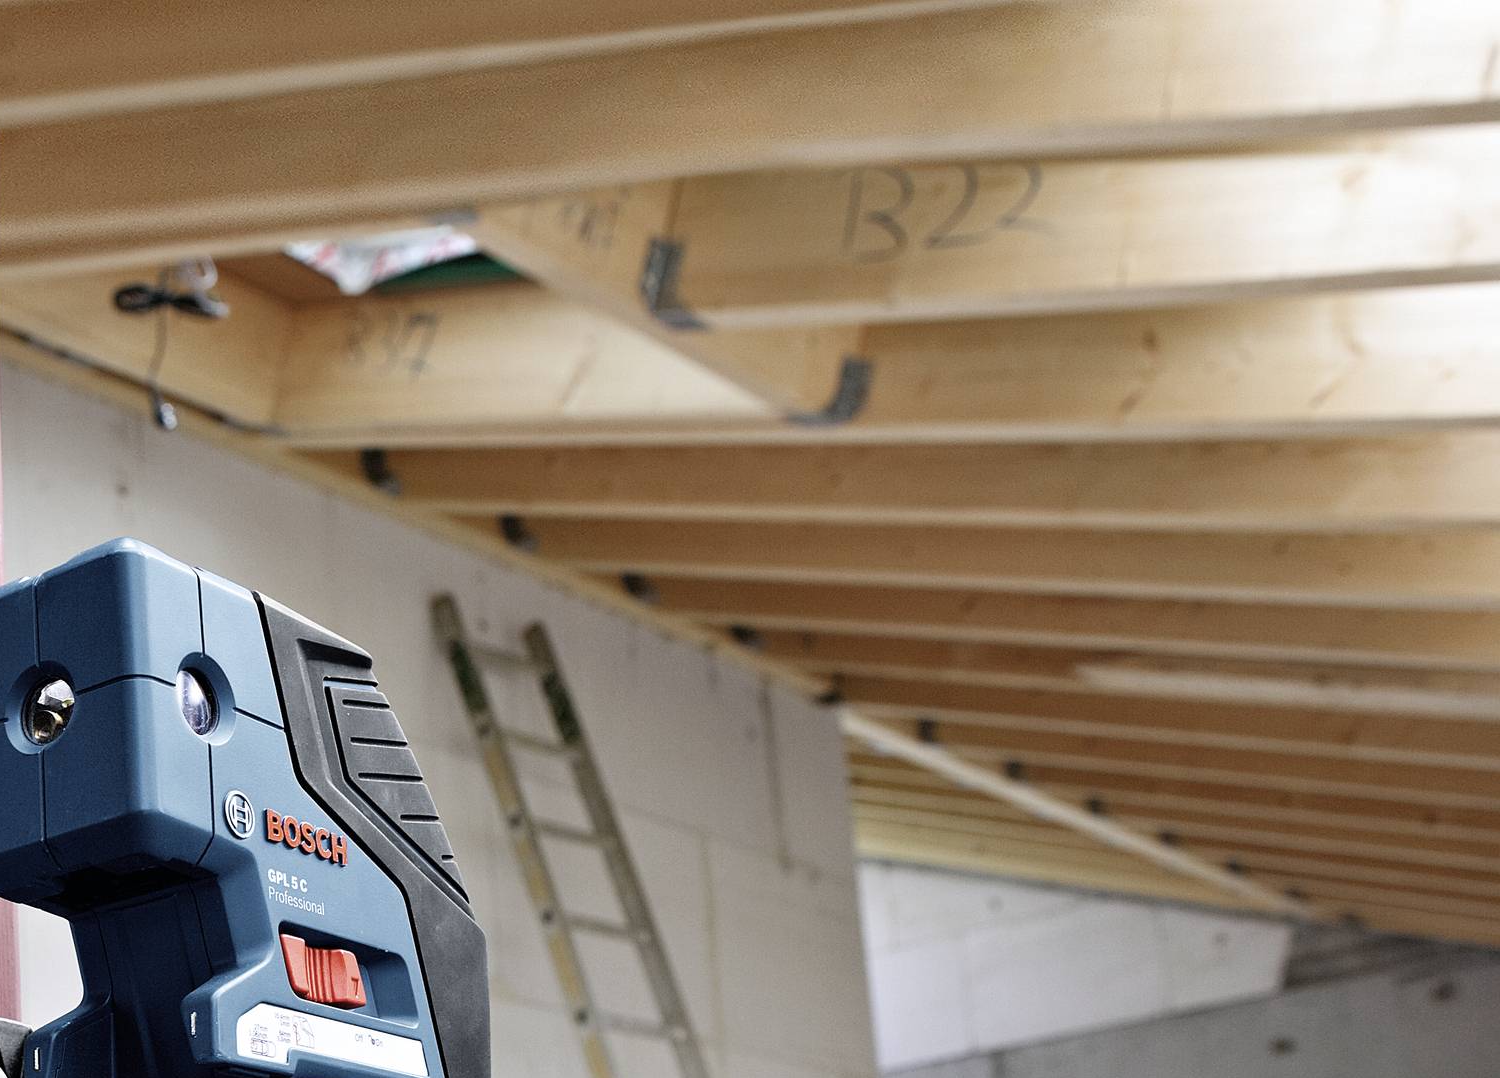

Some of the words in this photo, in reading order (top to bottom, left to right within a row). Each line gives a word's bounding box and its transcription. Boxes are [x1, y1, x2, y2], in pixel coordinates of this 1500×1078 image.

[841, 163, 1058, 262] B22
[265, 808, 348, 867] BOSCH
[267, 868, 290, 888] GPL
[291, 875, 299, 890] 5
[299, 878, 308, 893] C
[268, 885, 325, 916] Professional
